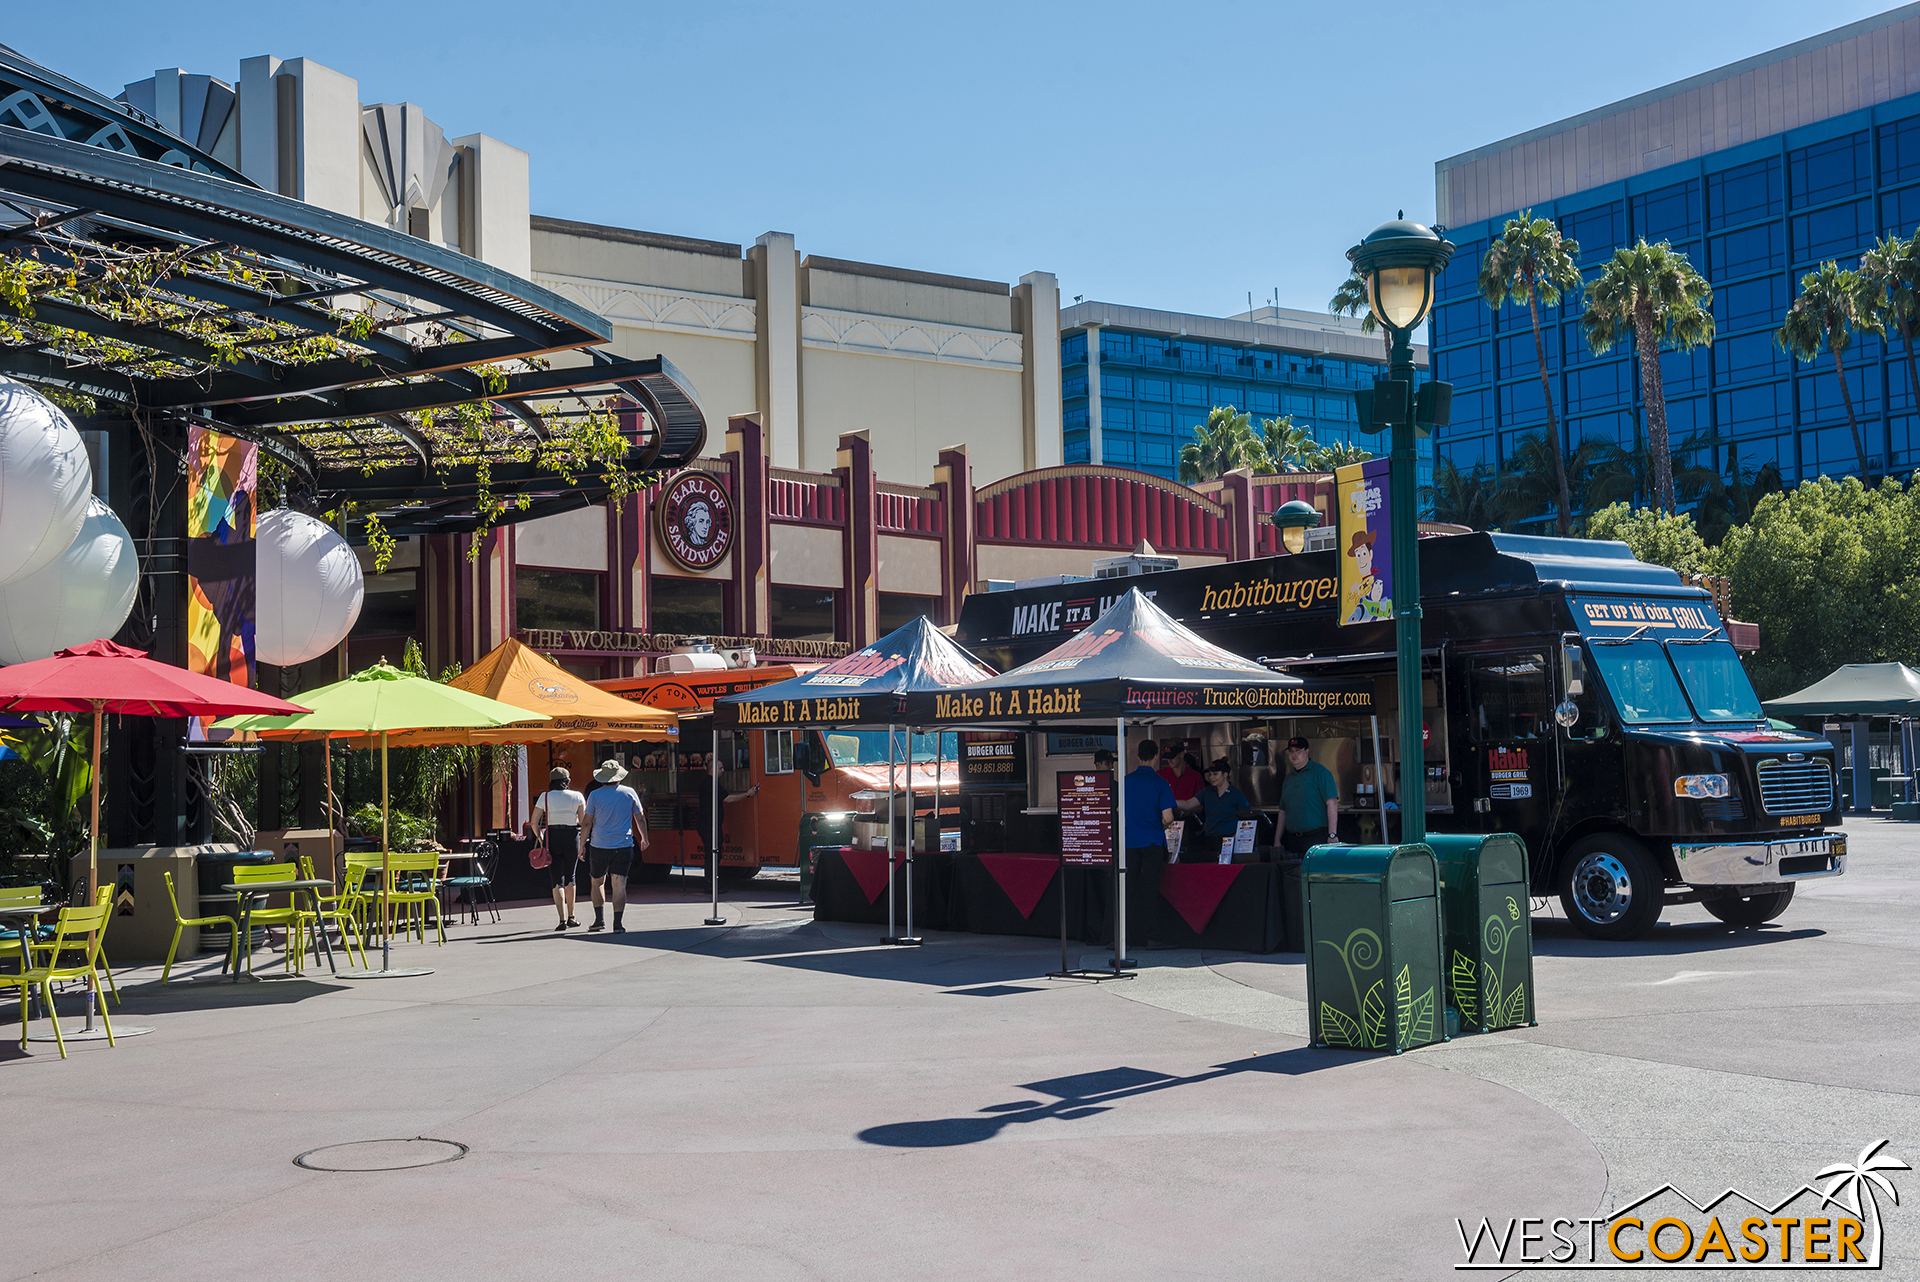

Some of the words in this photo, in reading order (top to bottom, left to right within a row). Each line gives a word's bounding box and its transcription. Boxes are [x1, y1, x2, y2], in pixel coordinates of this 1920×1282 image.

[671, 480, 706, 506] EARL
[709, 489, 726, 509] OF
[1351, 487, 1381, 504] PIXAR
[1357, 498, 1382, 512] FEST
[668, 525, 728, 563] SANDWICH
[1012, 602, 1062, 635] MAKE
[1066, 608, 1080, 622] IT
[1082, 606, 1091, 621] A
[1584, 604, 1610, 618] GET
[1610, 605, 1627, 619] UP
[1628, 606, 1645, 620] IN
[1645, 606, 1672, 620] OUR
[1672, 606, 1712, 630] GRILL
[521, 628, 564, 648] THE
[772, 638, 850, 657] SANDWICH
[666, 689, 686, 700] TOP
[697, 685, 727, 694] WAFFLES
[1126, 687, 1198, 709] Inquiries:
[1203, 688, 1372, 710] Truck@HabitBurger.com
[738, 702, 779, 724] Make
[783, 700, 795, 722] It
[799, 700, 812, 721] A
[815, 696, 860, 720] Habit
[936, 694, 984, 718] Make
[989, 691, 1002, 716] It
[1008, 690, 1022, 715] A
[1027, 688, 1082, 714] Habit
[967, 744, 994, 756] BURGER
[994, 744, 1014, 755] GRILL
[1058, 738, 1084, 748] BURGER
[1085, 736, 1103, 747] GRILL
[968, 762, 1014, 774] 949.851.8881
[1488, 748, 1528, 770] Habit
[1513, 786, 1529, 796] 1969
[1780, 814, 1821, 826] #HABITBURGER
